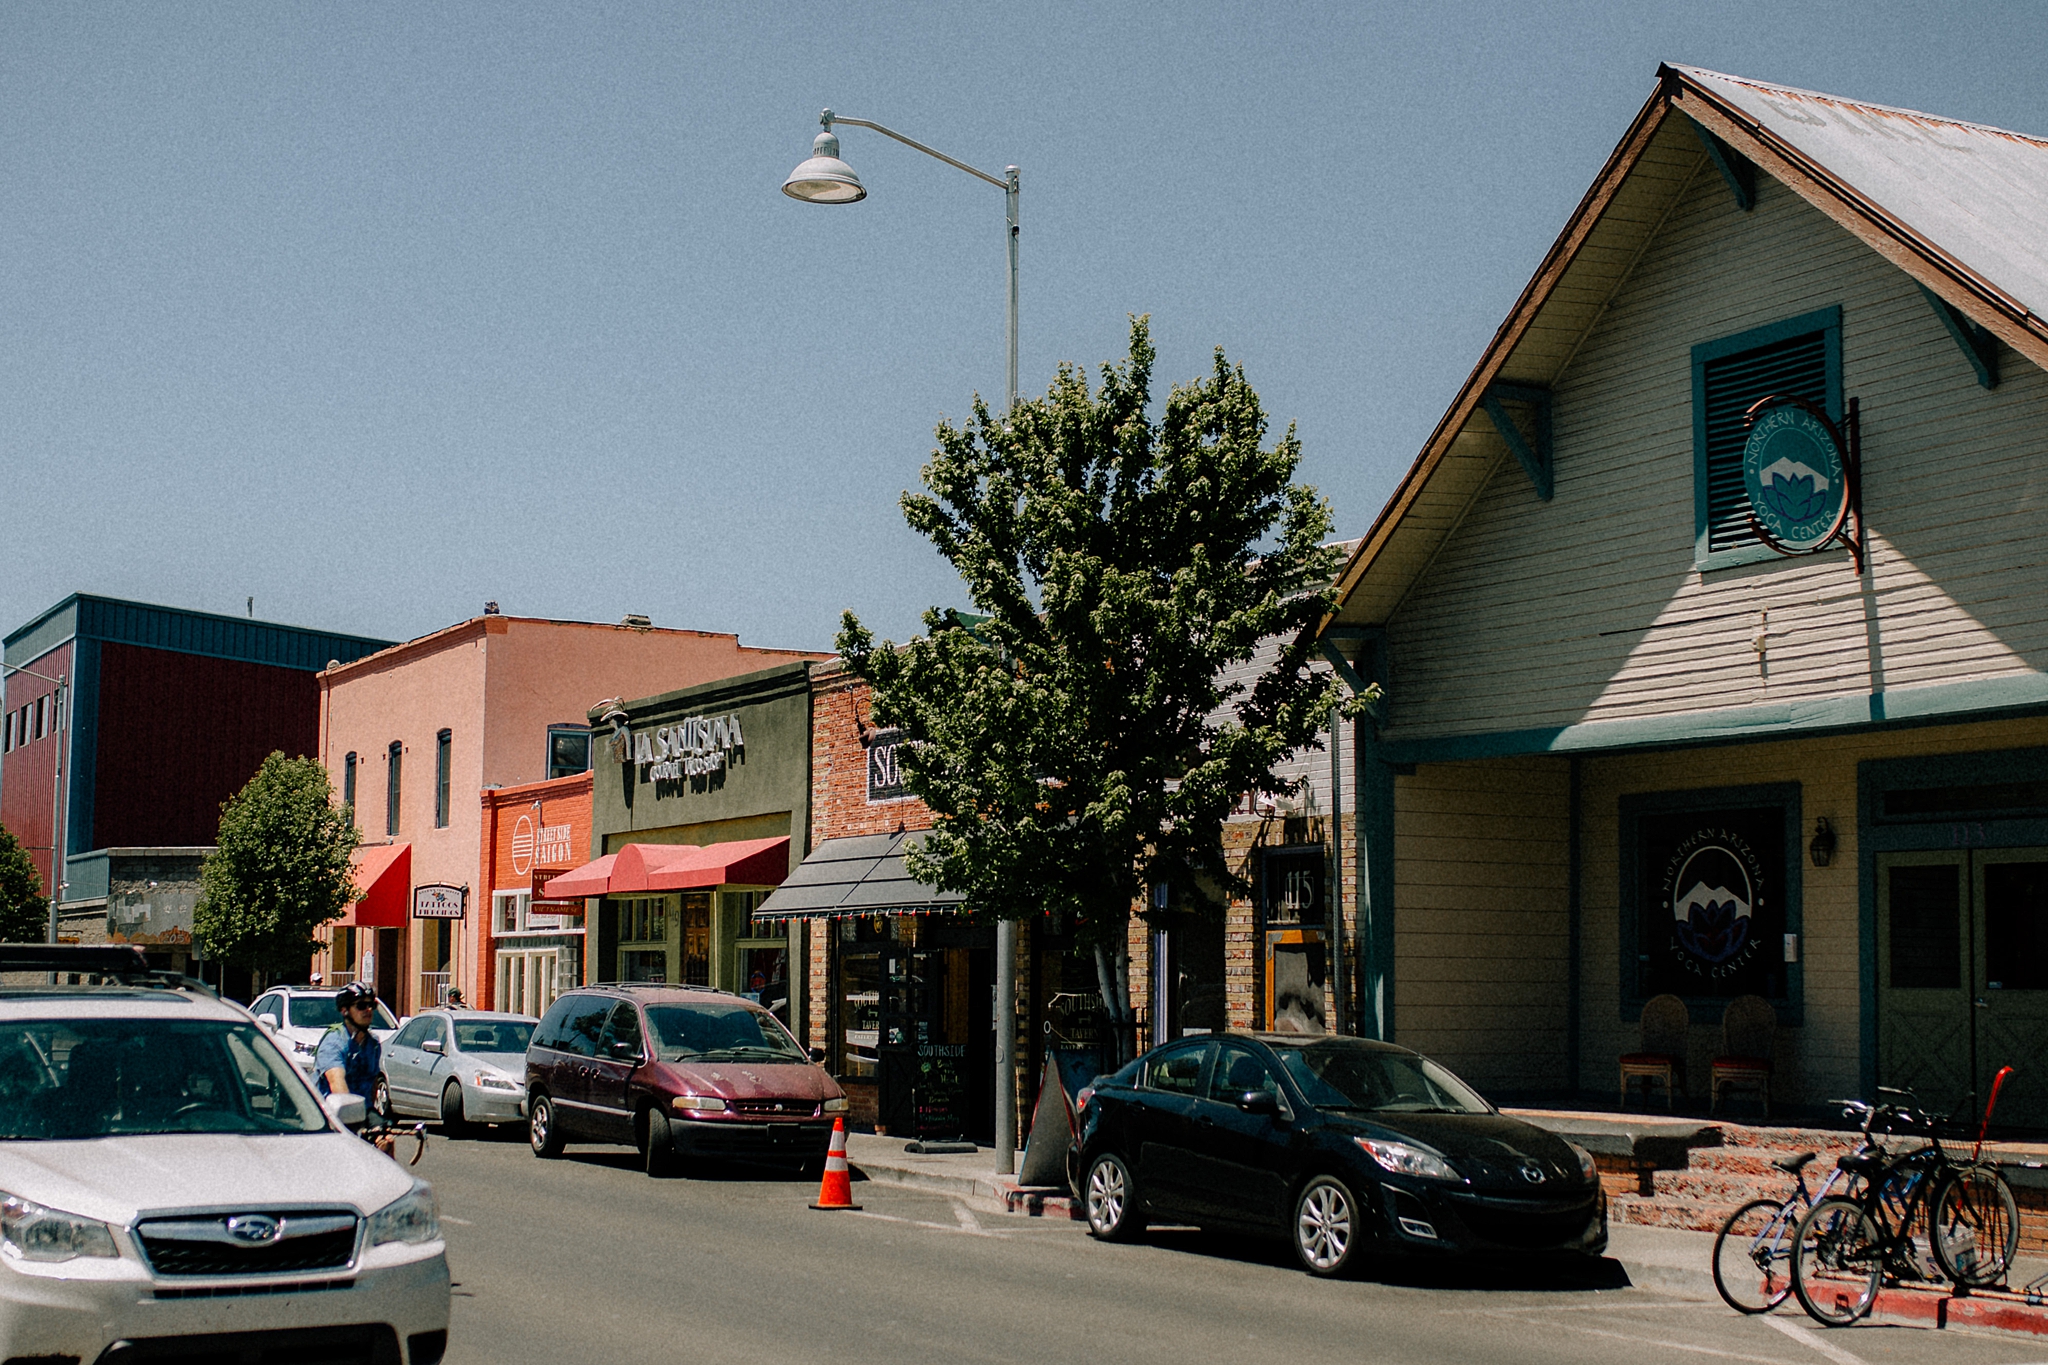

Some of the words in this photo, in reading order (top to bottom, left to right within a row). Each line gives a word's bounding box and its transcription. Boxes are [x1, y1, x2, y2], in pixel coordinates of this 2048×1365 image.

[1748, 412, 1795, 464] NORTHERN
[1802, 417, 1842, 476] ARIZONA
[1755, 493, 1783, 534] YOGA
[1791, 510, 1836, 539] CENTER
[634, 732, 654, 765] LA
[655, 713, 744, 763] SANTISIMA
[535, 842, 571, 864] SAIGON
[537, 826, 556, 843] STREET
[557, 824, 571, 840] SIDE
[1662, 827, 1716, 892] NORTHERN
[1719, 828, 1766, 892] ARIZONA
[533, 905, 580, 914] VIETNAMESE
[1287, 870, 1313, 910] 115
[1669, 936, 1702, 977] YOGA
[1711, 938, 1767, 979] CENTER
[917, 1044, 967, 1057] SOUTHSIDE
